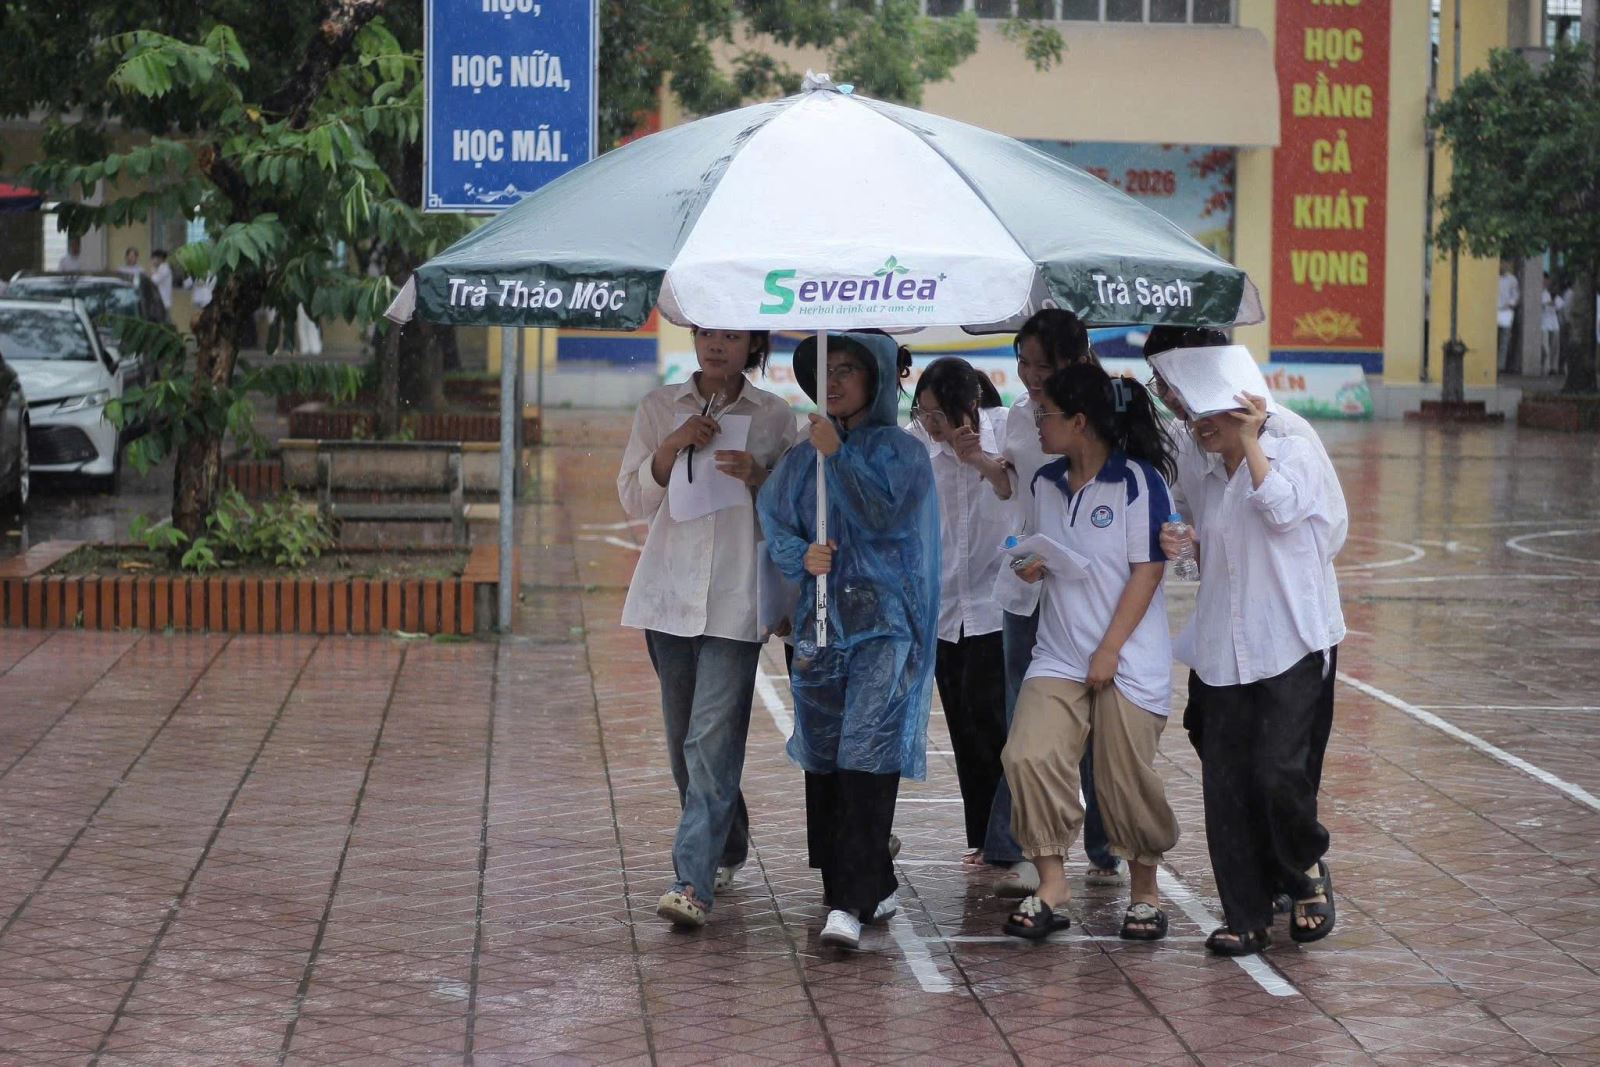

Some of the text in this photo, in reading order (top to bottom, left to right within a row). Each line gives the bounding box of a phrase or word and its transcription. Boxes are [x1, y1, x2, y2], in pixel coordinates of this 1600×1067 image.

[1304, 27, 1363, 68] HỌC
[451, 50, 571, 94] HỌC NỮA,
[1293, 71, 1373, 118] BẰNG
[453, 124, 569, 168] HỌC MÃI.
[1312, 128, 1352, 174] CẢ
[1125, 168, 1176, 195] 2026
[1294, 188, 1369, 230] KHÁT
[1291, 250, 1369, 292] VỌNG
[448, 278, 626, 318] Trà Thảo Mộc
[799, 304, 834, 316] Herbal
[836, 304, 864, 315] drink
[866, 305, 877, 313] at
[880, 305, 888, 313] 7
[889, 305, 904, 313] am
[918, 304, 935, 315] pm
[1092, 274, 1192, 313] Trà Sạch
